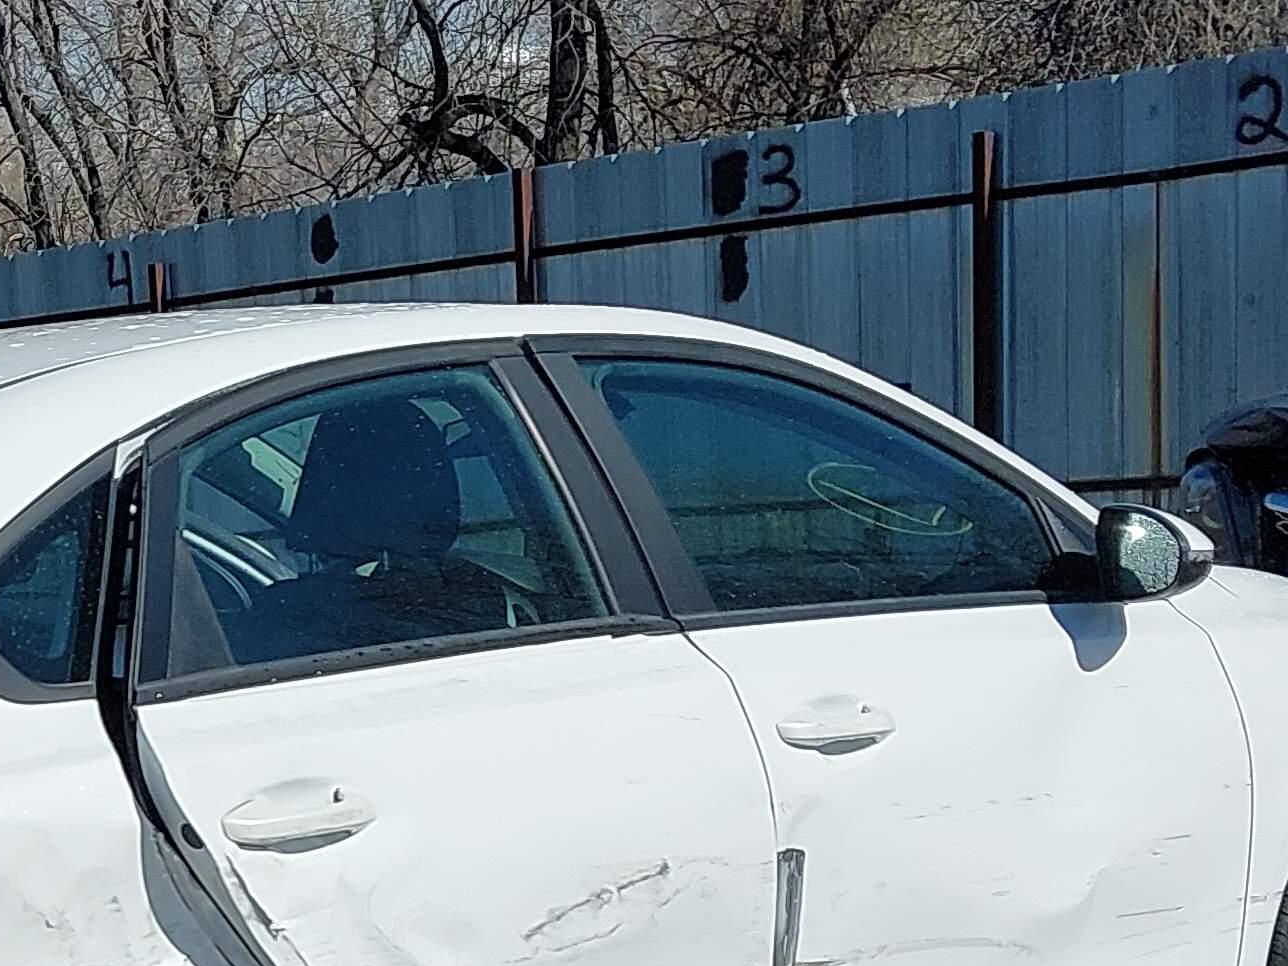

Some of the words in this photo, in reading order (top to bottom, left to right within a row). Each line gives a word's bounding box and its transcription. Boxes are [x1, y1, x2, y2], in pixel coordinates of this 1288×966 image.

[1237, 74, 1288, 145] 2
[758, 144, 802, 216] 3
[107, 249, 133, 305] 4
